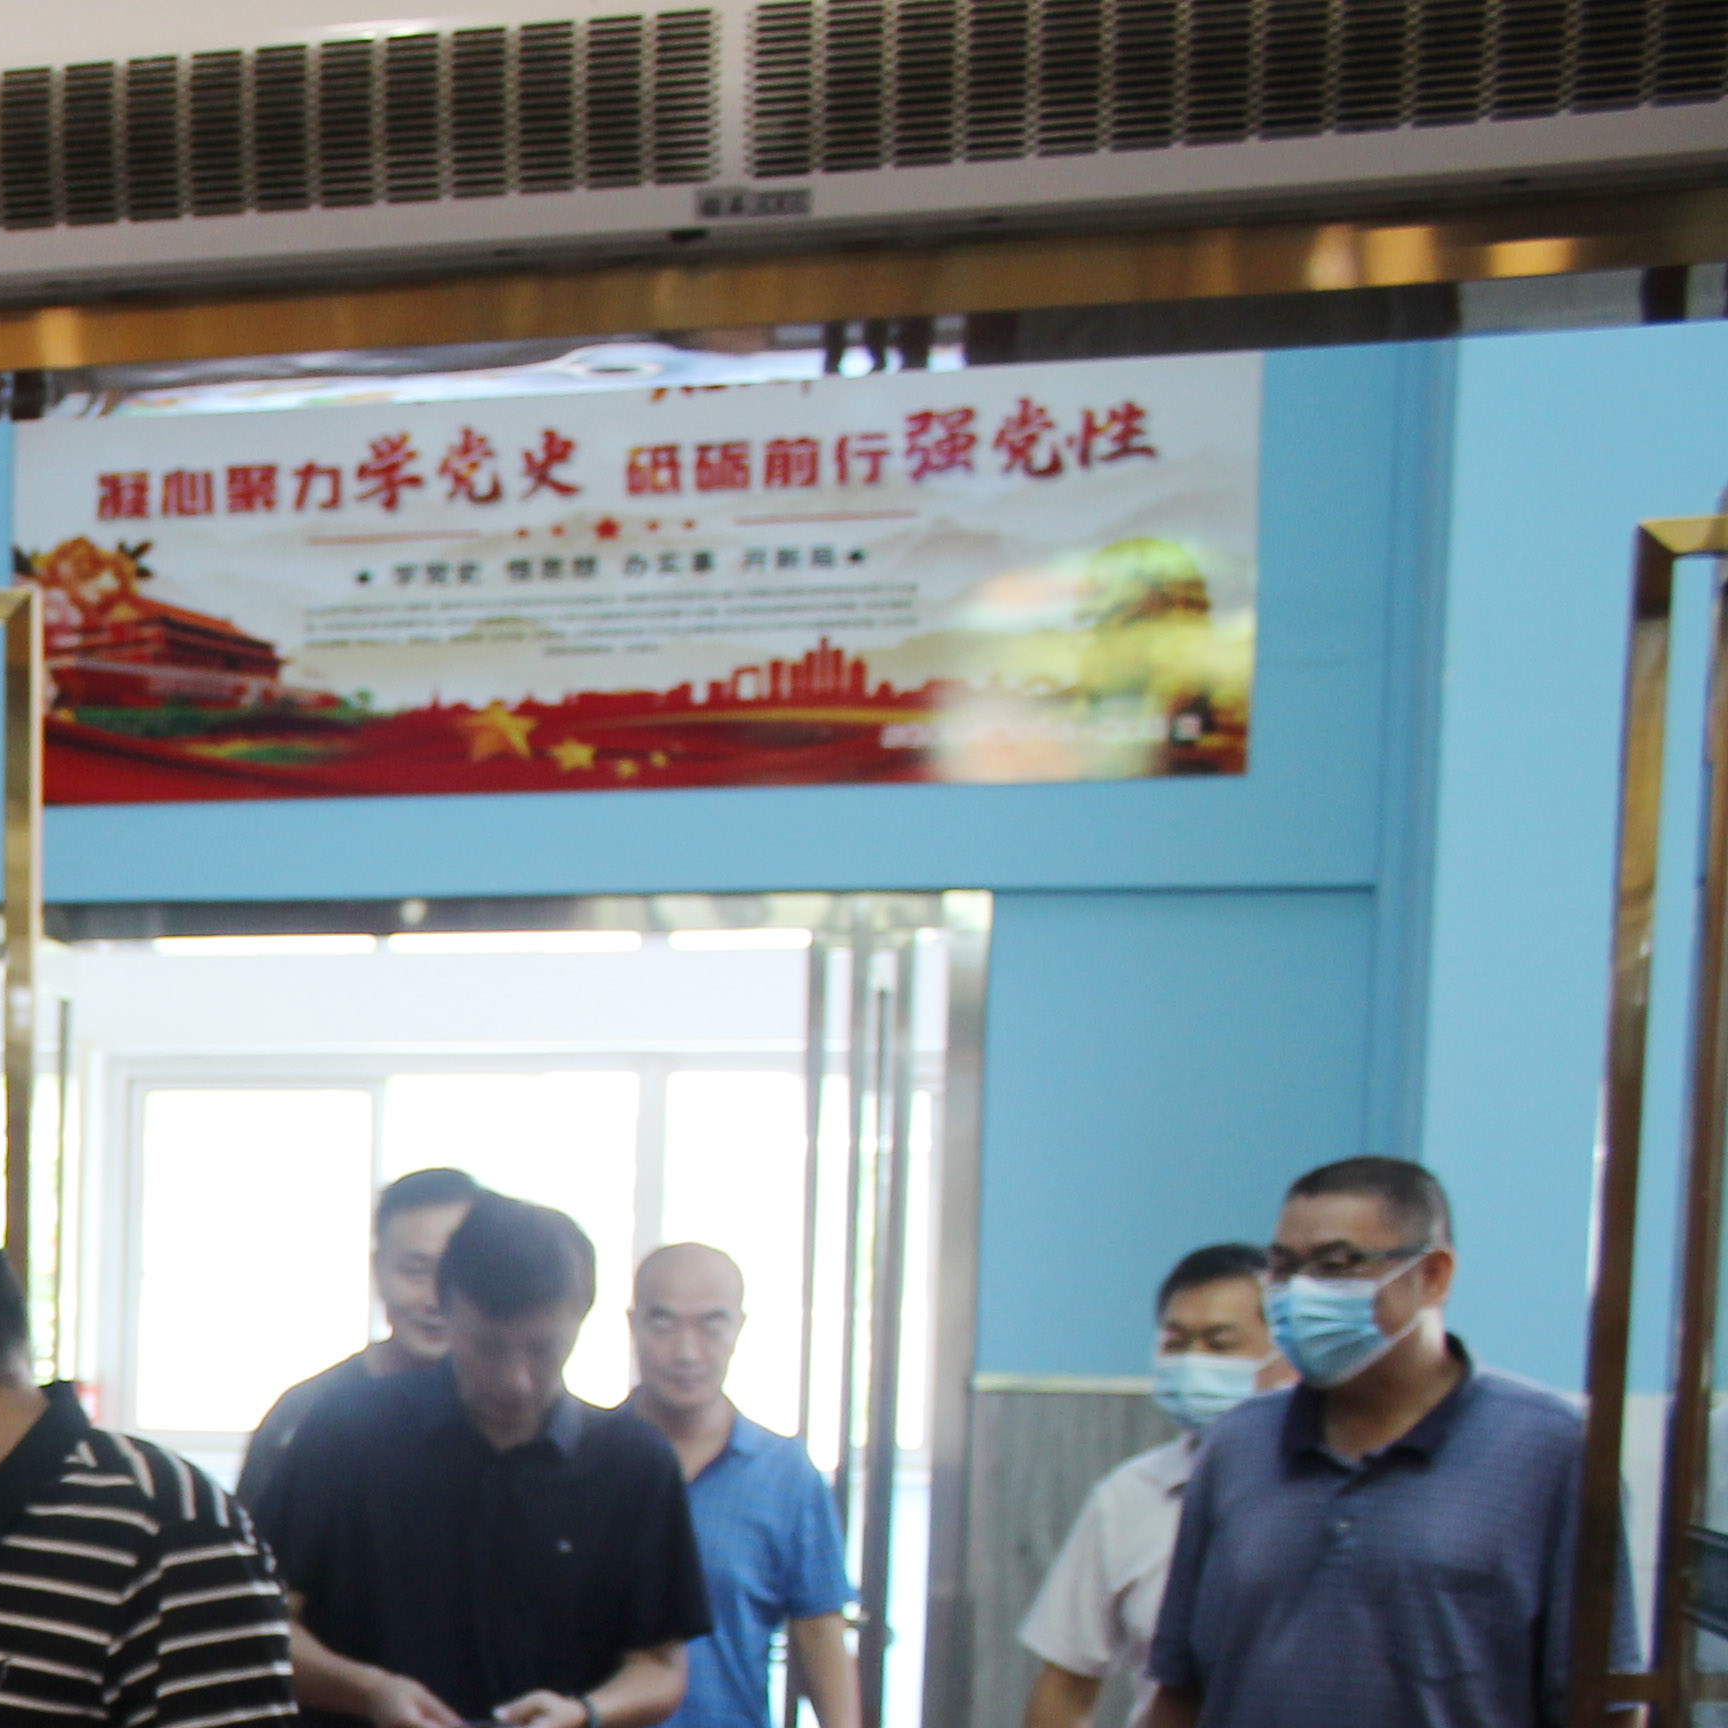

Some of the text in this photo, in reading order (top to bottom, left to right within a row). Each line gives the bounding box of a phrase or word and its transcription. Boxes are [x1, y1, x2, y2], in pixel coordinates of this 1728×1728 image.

[97, 399, 1158, 521] 凝心聚力学党史 砥砺前行强党性
